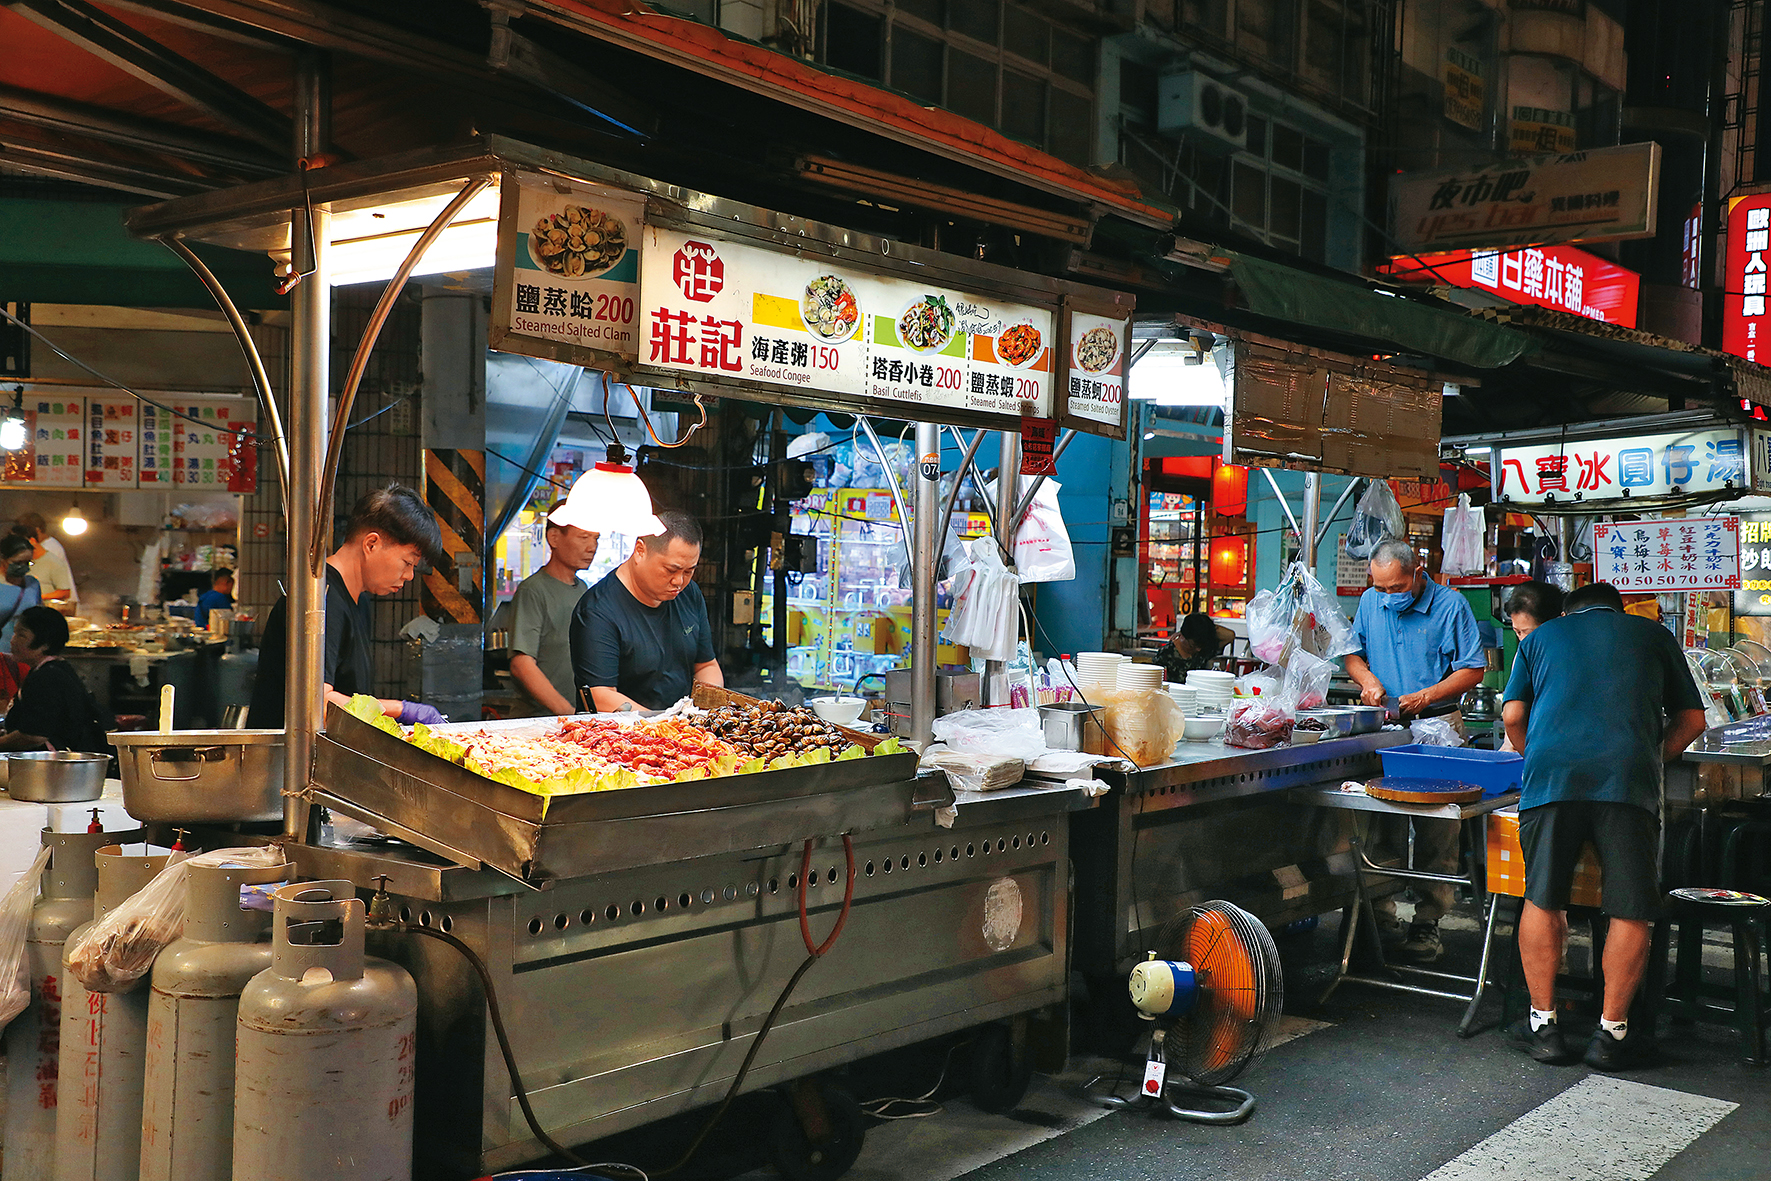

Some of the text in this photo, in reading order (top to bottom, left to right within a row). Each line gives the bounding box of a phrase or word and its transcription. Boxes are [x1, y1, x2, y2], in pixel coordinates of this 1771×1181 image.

[1742, 207, 1770, 316] 歐洲人玩具
[516, 283, 634, 325] 鹽蒸蛤 200
[515, 316, 631, 342] Steamed Salted Clam
[650, 307, 744, 373] 莊記
[751, 335, 840, 371] 海產粥 150
[750, 363, 811, 385] Seafood Congee
[872, 356, 962, 391] 塔香小卷 200
[971, 371, 1039, 400] 鹽蒸蝦 200
[872, 385, 923, 402] Basil Cuttlefis
[970, 395, 1040, 415] Steamed Salted Shrimps
[1101, 383, 1122, 404] 200
[1069, 399, 1120, 416] Steamed Salted Oyster
[1633, 529, 1651, 573] 烏梅冰
[1679, 525, 1698, 571] 紅豆牛奶冰
[1704, 524, 1722, 571] 巧克力牛奶冰
[1612, 576, 1630, 586] 60
[1634, 575, 1653, 586] 50
[1656, 575, 1676, 585] 50
[1679, 575, 1698, 585] 70
[1704, 574, 1723, 584] 60
